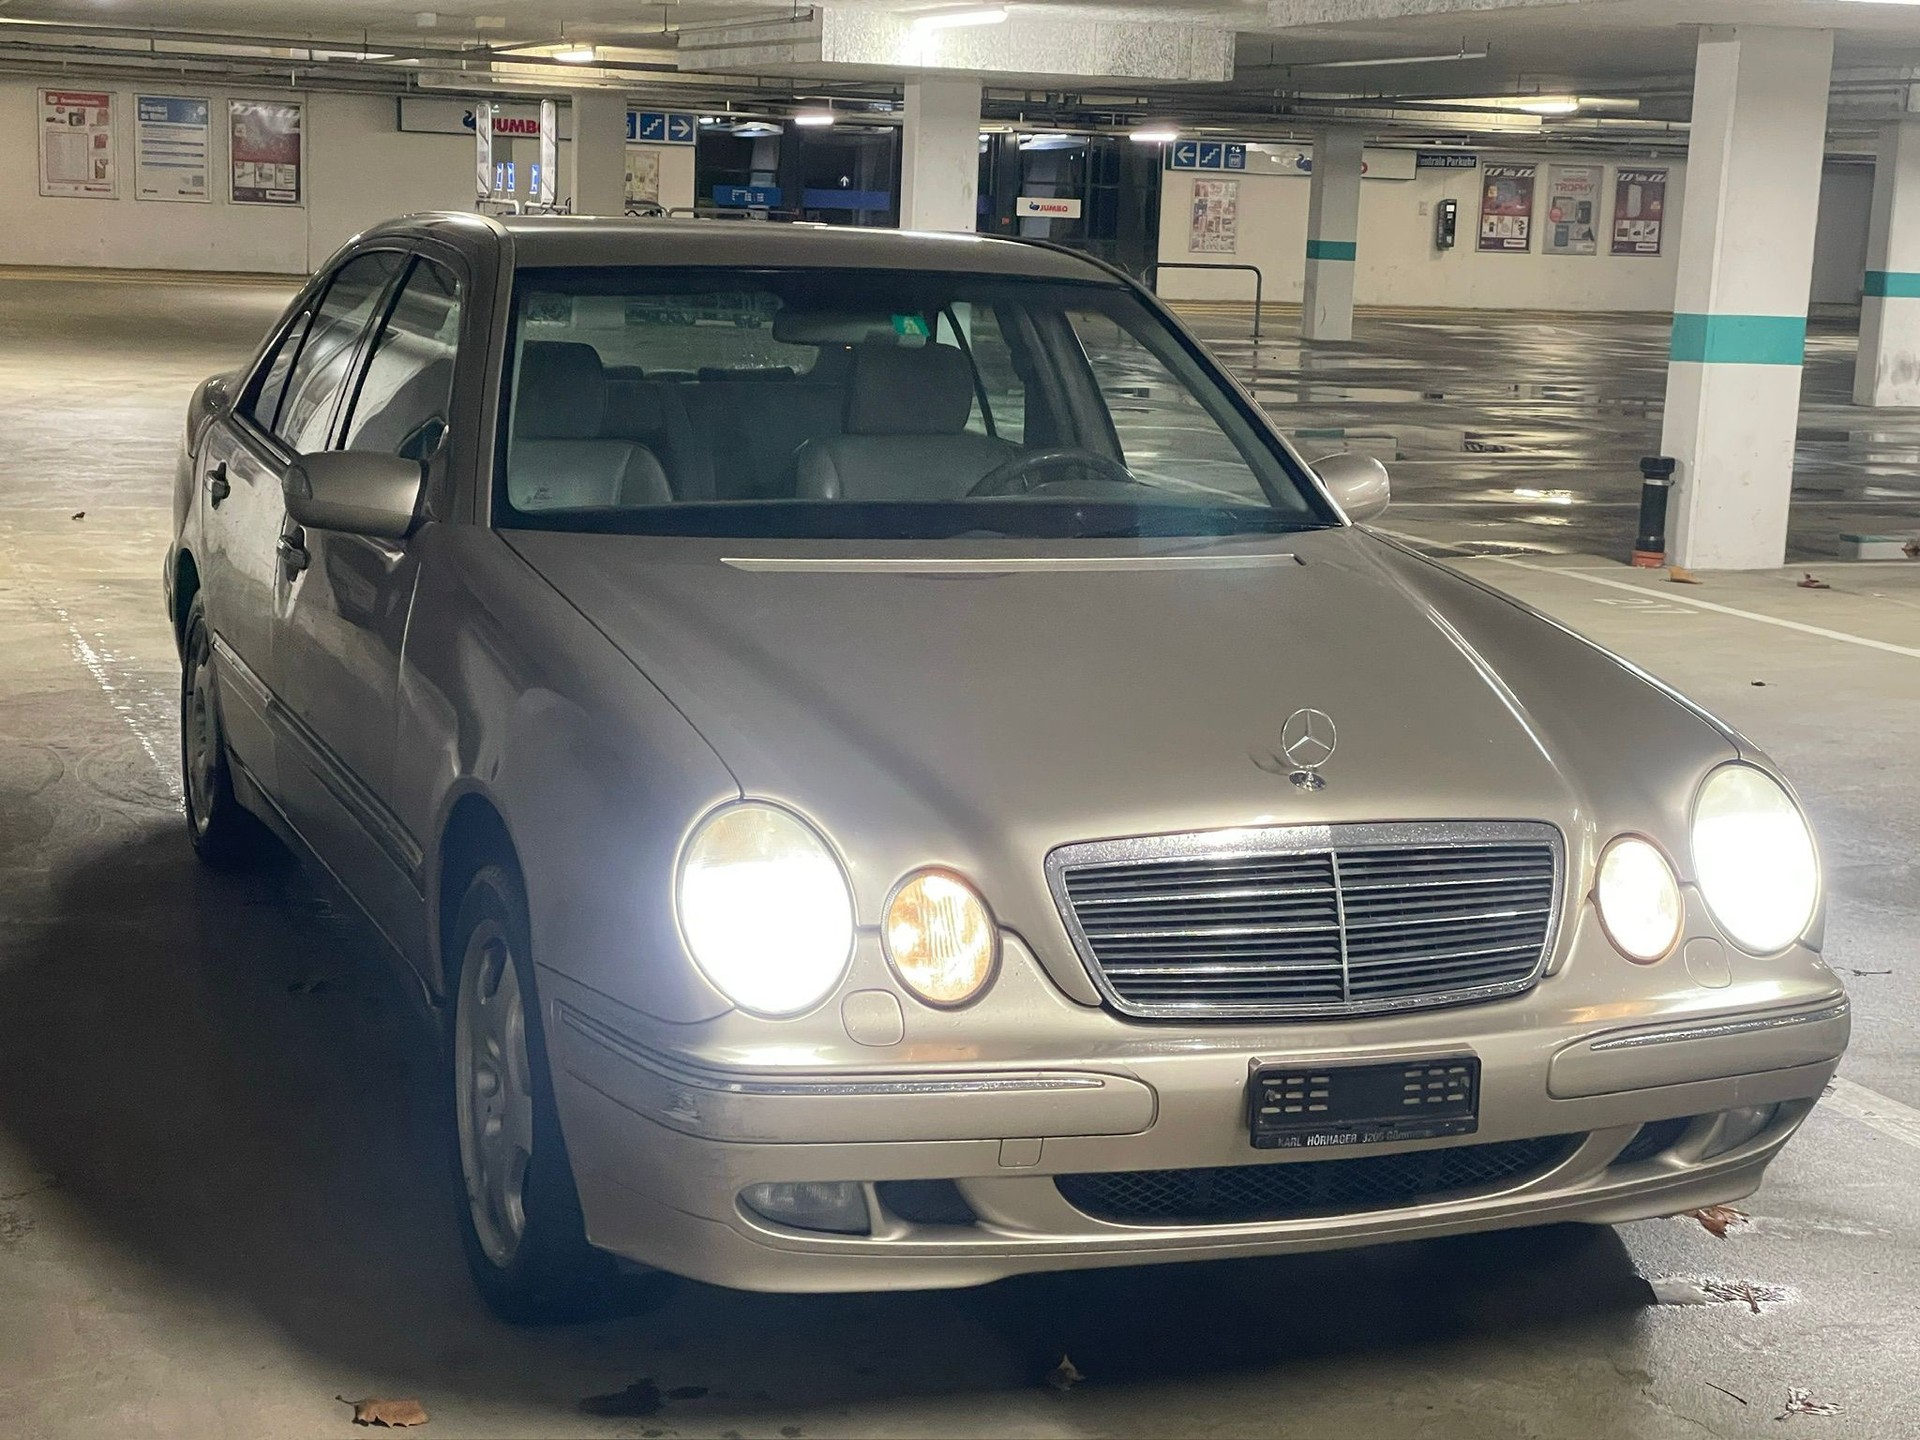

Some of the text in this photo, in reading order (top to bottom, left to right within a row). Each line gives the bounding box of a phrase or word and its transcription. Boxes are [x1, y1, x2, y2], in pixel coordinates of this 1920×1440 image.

[1418, 156, 1476, 166] entrale Parkuhr
[1555, 182, 1595, 193] TROPHY
[1039, 204, 1068, 213] JUMBO
